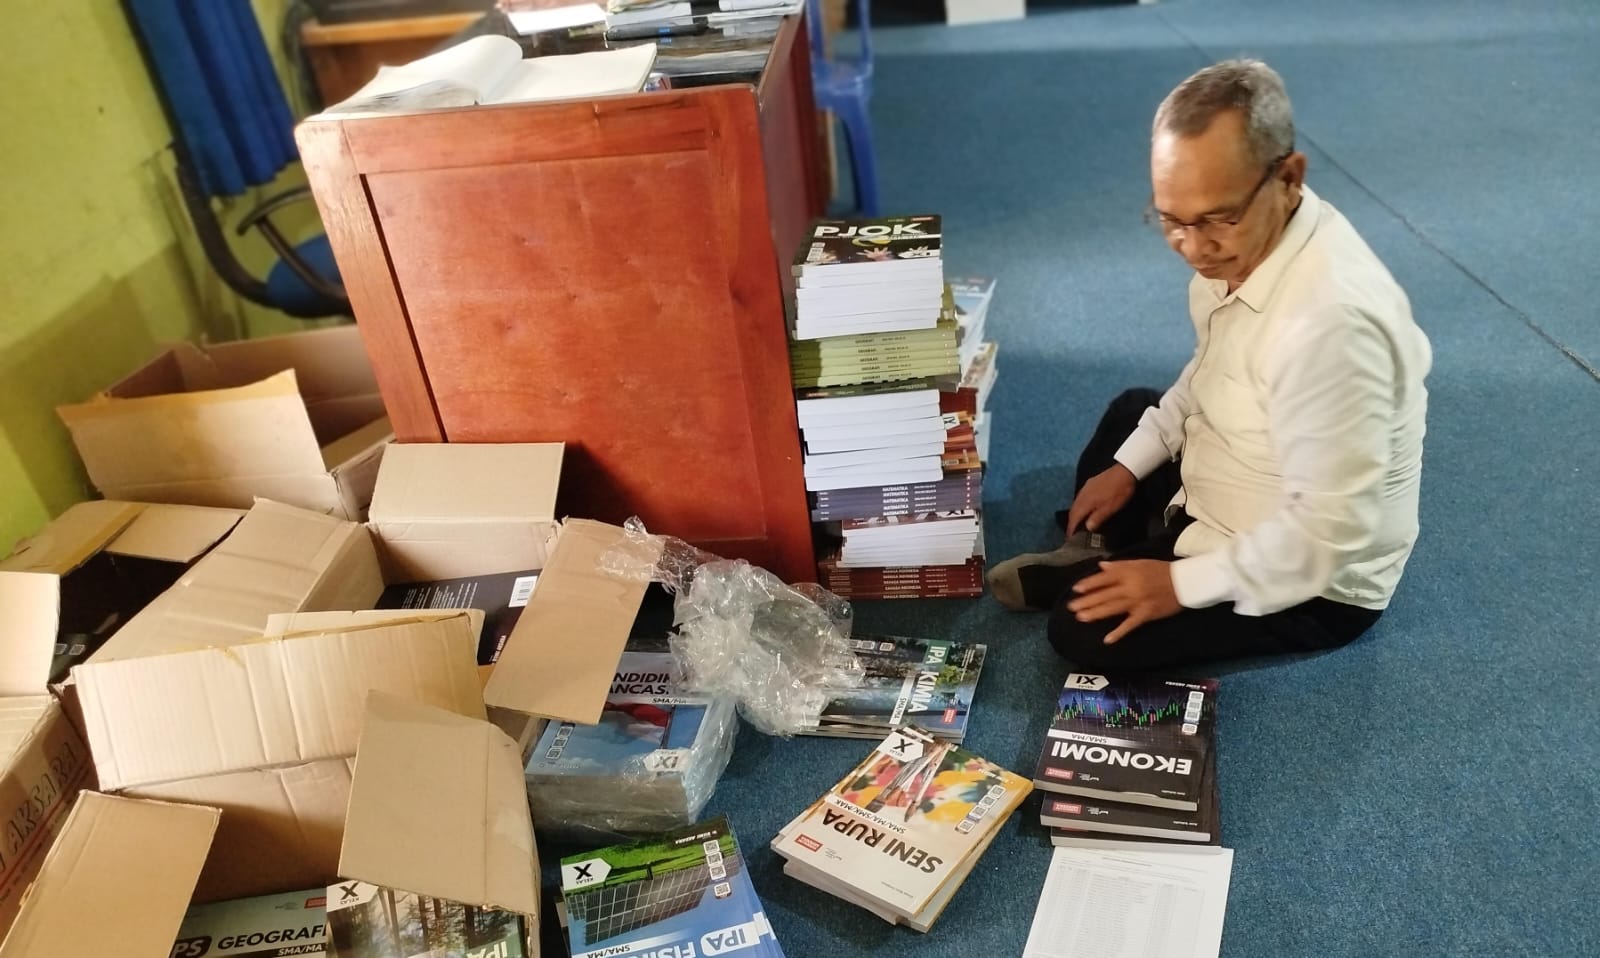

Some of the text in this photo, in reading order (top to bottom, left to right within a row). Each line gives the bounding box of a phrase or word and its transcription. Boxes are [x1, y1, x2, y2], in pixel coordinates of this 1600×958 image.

[814, 223, 926, 237] PJOK
[908, 646, 947, 712] IPA KIMIA
[1076, 676, 1099, 685] XI
[893, 739, 914, 753] X
[1072, 733, 1107, 743] SMA/MA
[1051, 741, 1192, 775] EKONOMI
[823, 808, 885, 848] RUPA
[882, 839, 943, 873] SENI
[573, 863, 593, 880] X
[339, 883, 359, 900] X
[707, 928, 745, 951] IPA
[170, 940, 203, 958] PS
[277, 944, 323, 956] SMA/MA
